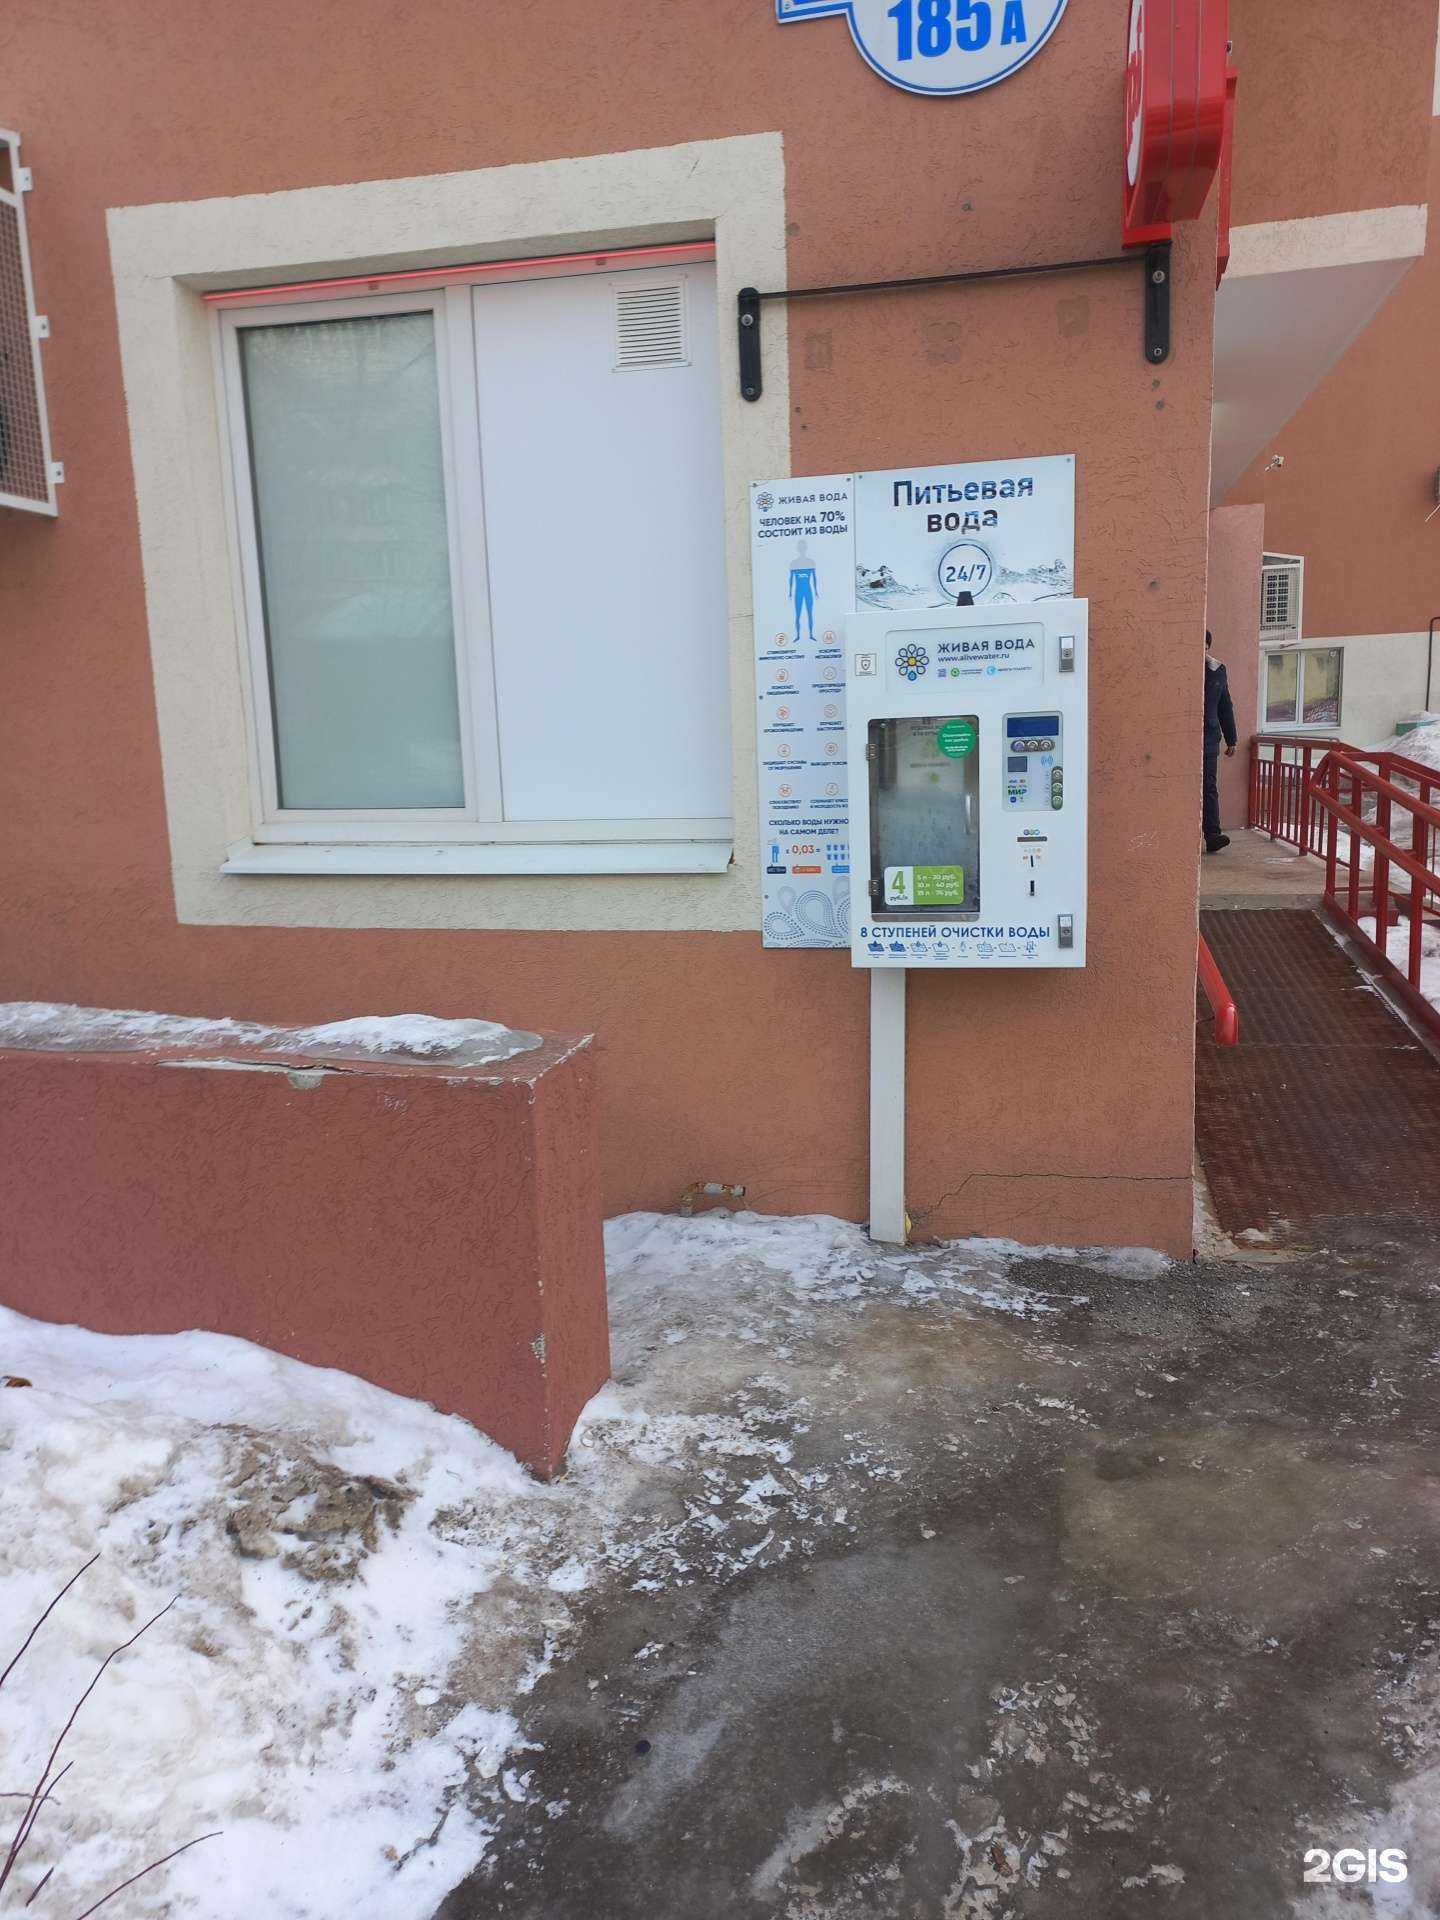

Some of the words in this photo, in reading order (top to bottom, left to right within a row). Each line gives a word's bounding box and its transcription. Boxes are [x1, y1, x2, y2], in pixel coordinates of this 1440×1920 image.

[887, 0, 991, 61] 185
[778, 494, 816, 505] ЖИВАЯ
[819, 492, 848, 502] ВОДА
[893, 476, 1034, 507] Питьевая
[759, 516, 802, 527] ЧЕЛОВЕК
[803, 515, 817, 524] НА
[820, 510, 846, 522] 70%
[927, 508, 998, 535] вода
[758, 527, 803, 538] СОСТОИТ
[805, 526, 817, 536] ИЗ
[819, 524, 848, 535] ВОДЫ
[946, 564, 987, 583] 24/7
[937, 641, 990, 654] ЖИВАЯ
[995, 638, 1036, 651] ВОДА
[937, 652, 1010, 663] www.alivewater.ru
[802, 818, 823, 826] ВОДЫ
[823, 817, 849, 825] НУЖНО
[791, 844, 815, 855] 0,03
[891, 869, 906, 895] 4
[860, 927, 868, 938] 8
[871, 925, 937, 938] СТУПЕНЕЙ
[941, 926, 1004, 938] ОЧИСТКИ
[1008, 926, 1051, 939] ВОДЫ
